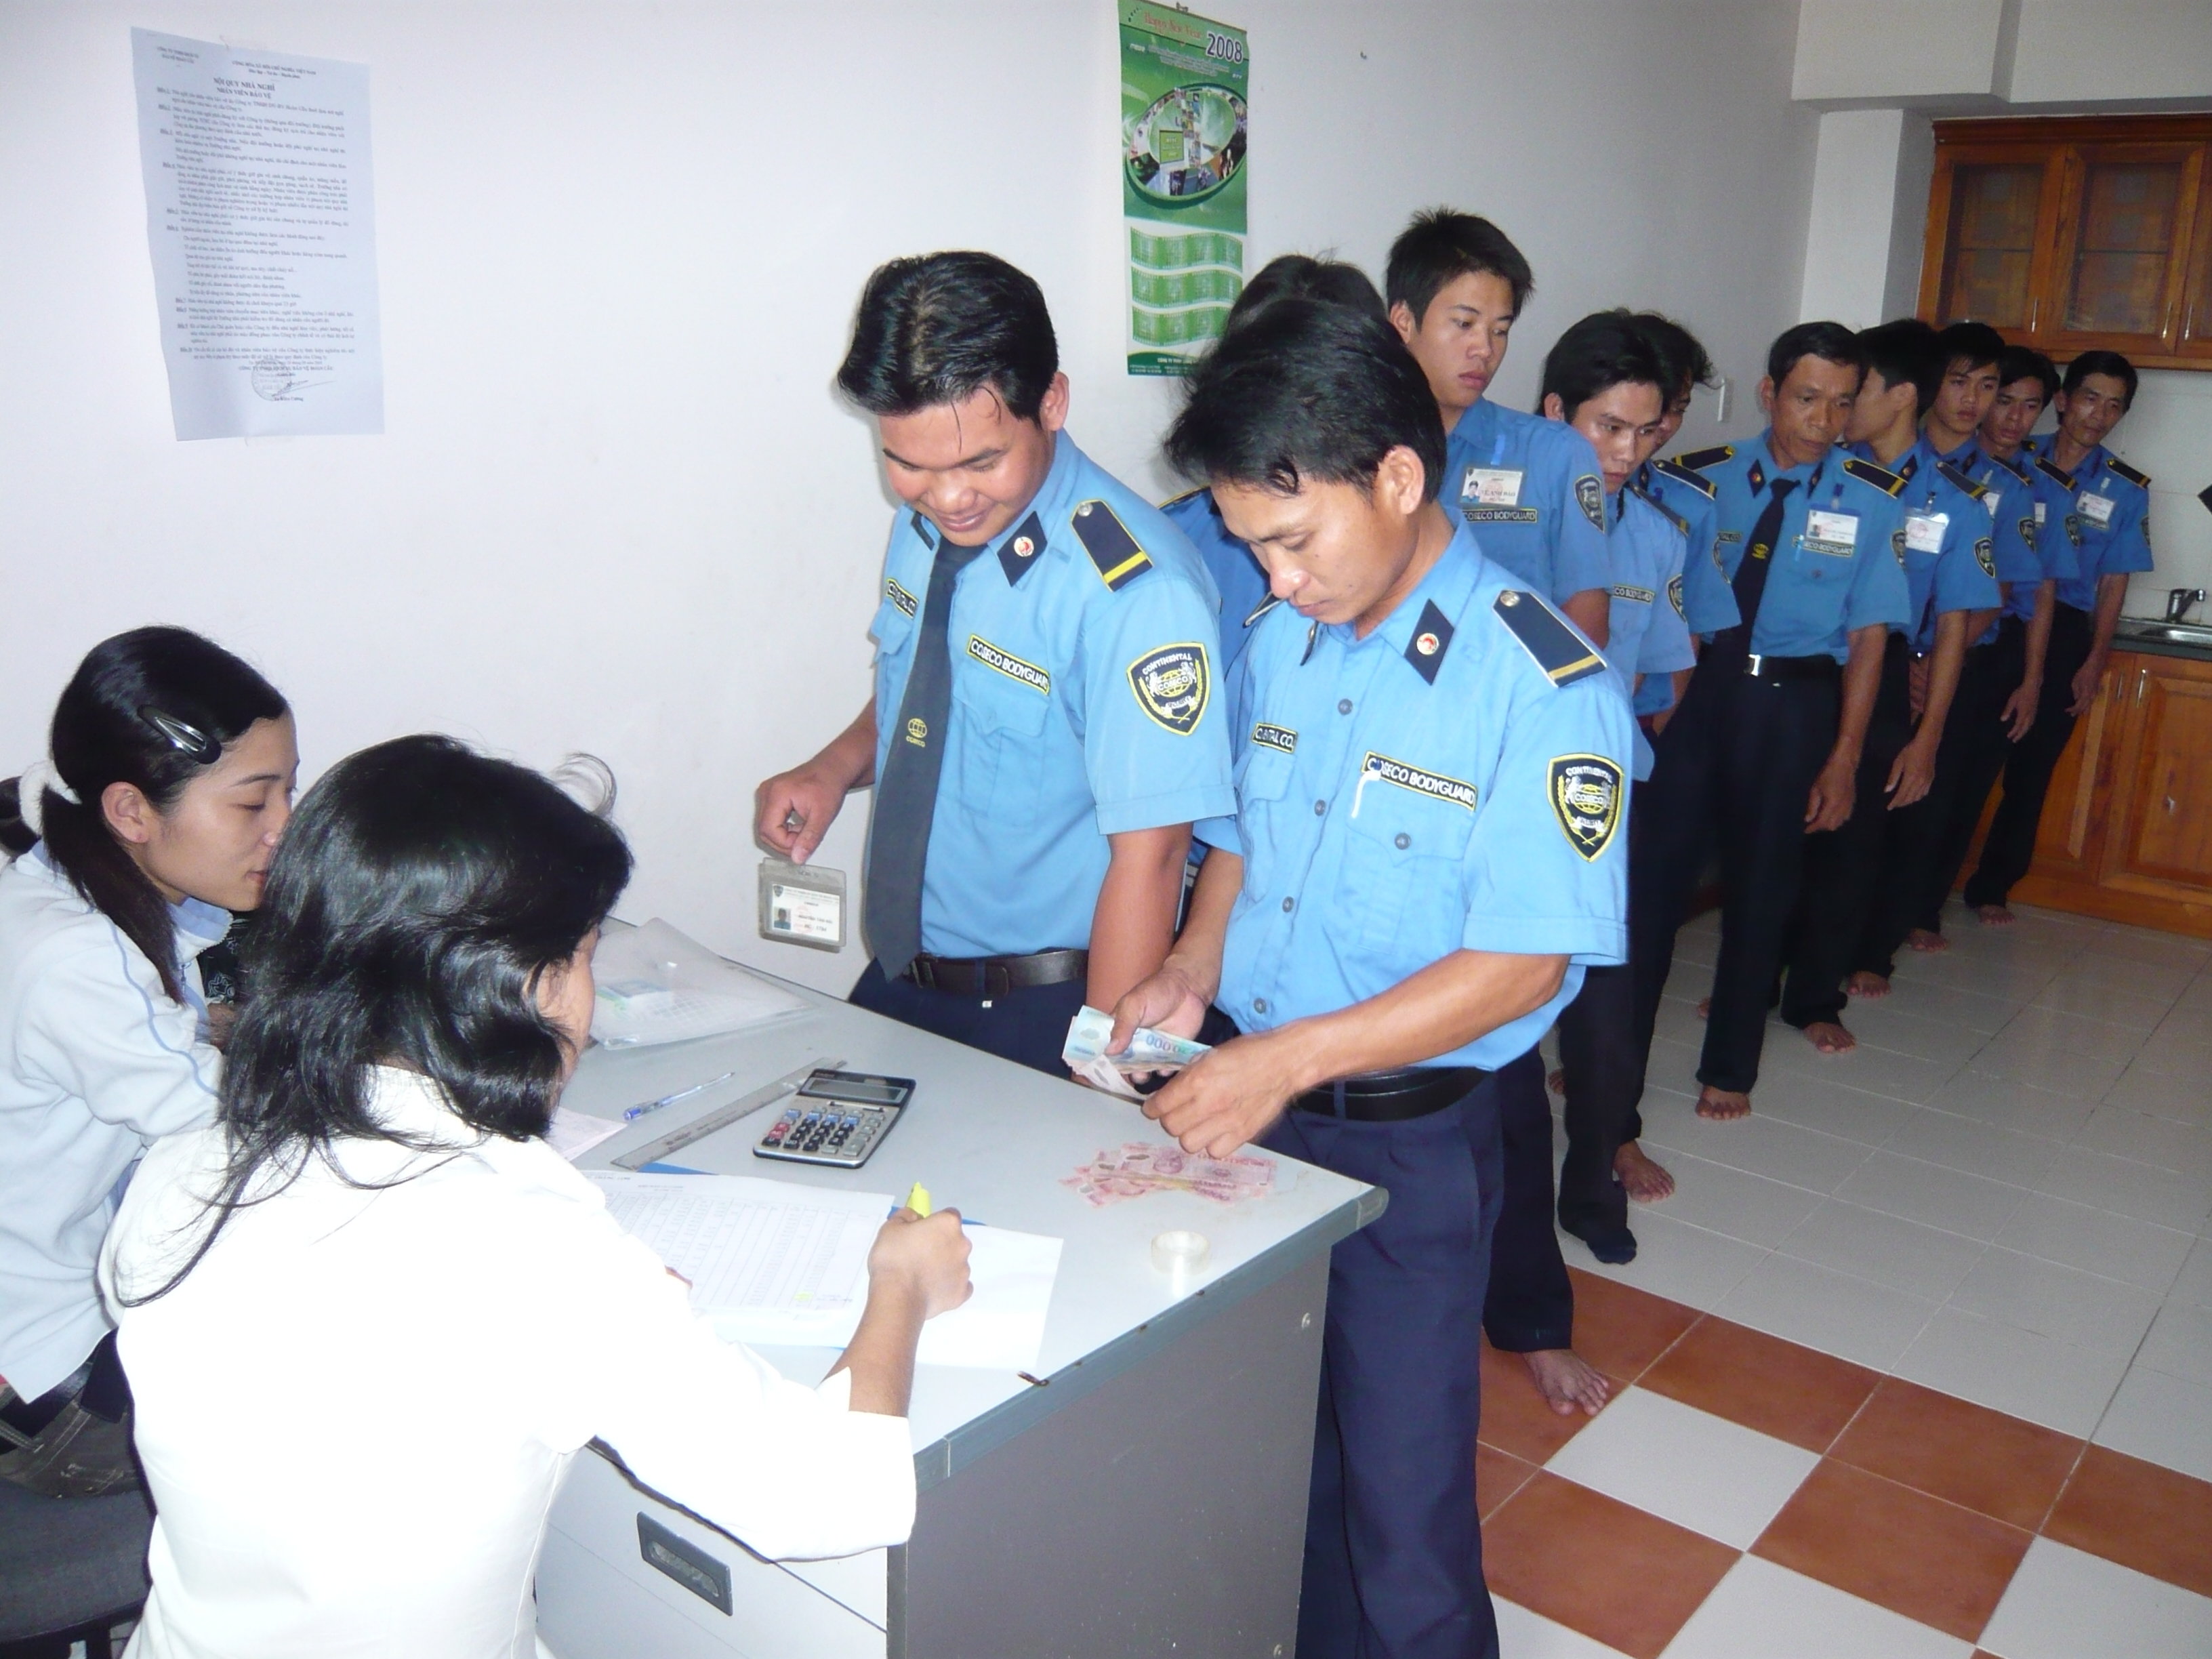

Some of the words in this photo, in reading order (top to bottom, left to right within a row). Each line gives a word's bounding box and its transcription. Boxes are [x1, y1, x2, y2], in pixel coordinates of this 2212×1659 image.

[1207, 31, 1243, 64] 2008
[1494, 512, 1536, 521] BODYGUARD
[971, 640, 1002, 667] COSECO
[1143, 653, 1193, 676] CONTINENTAL
[1565, 766, 1614, 783] CONTINENTAL
[1409, 772, 1475, 805] BODYGUARD
